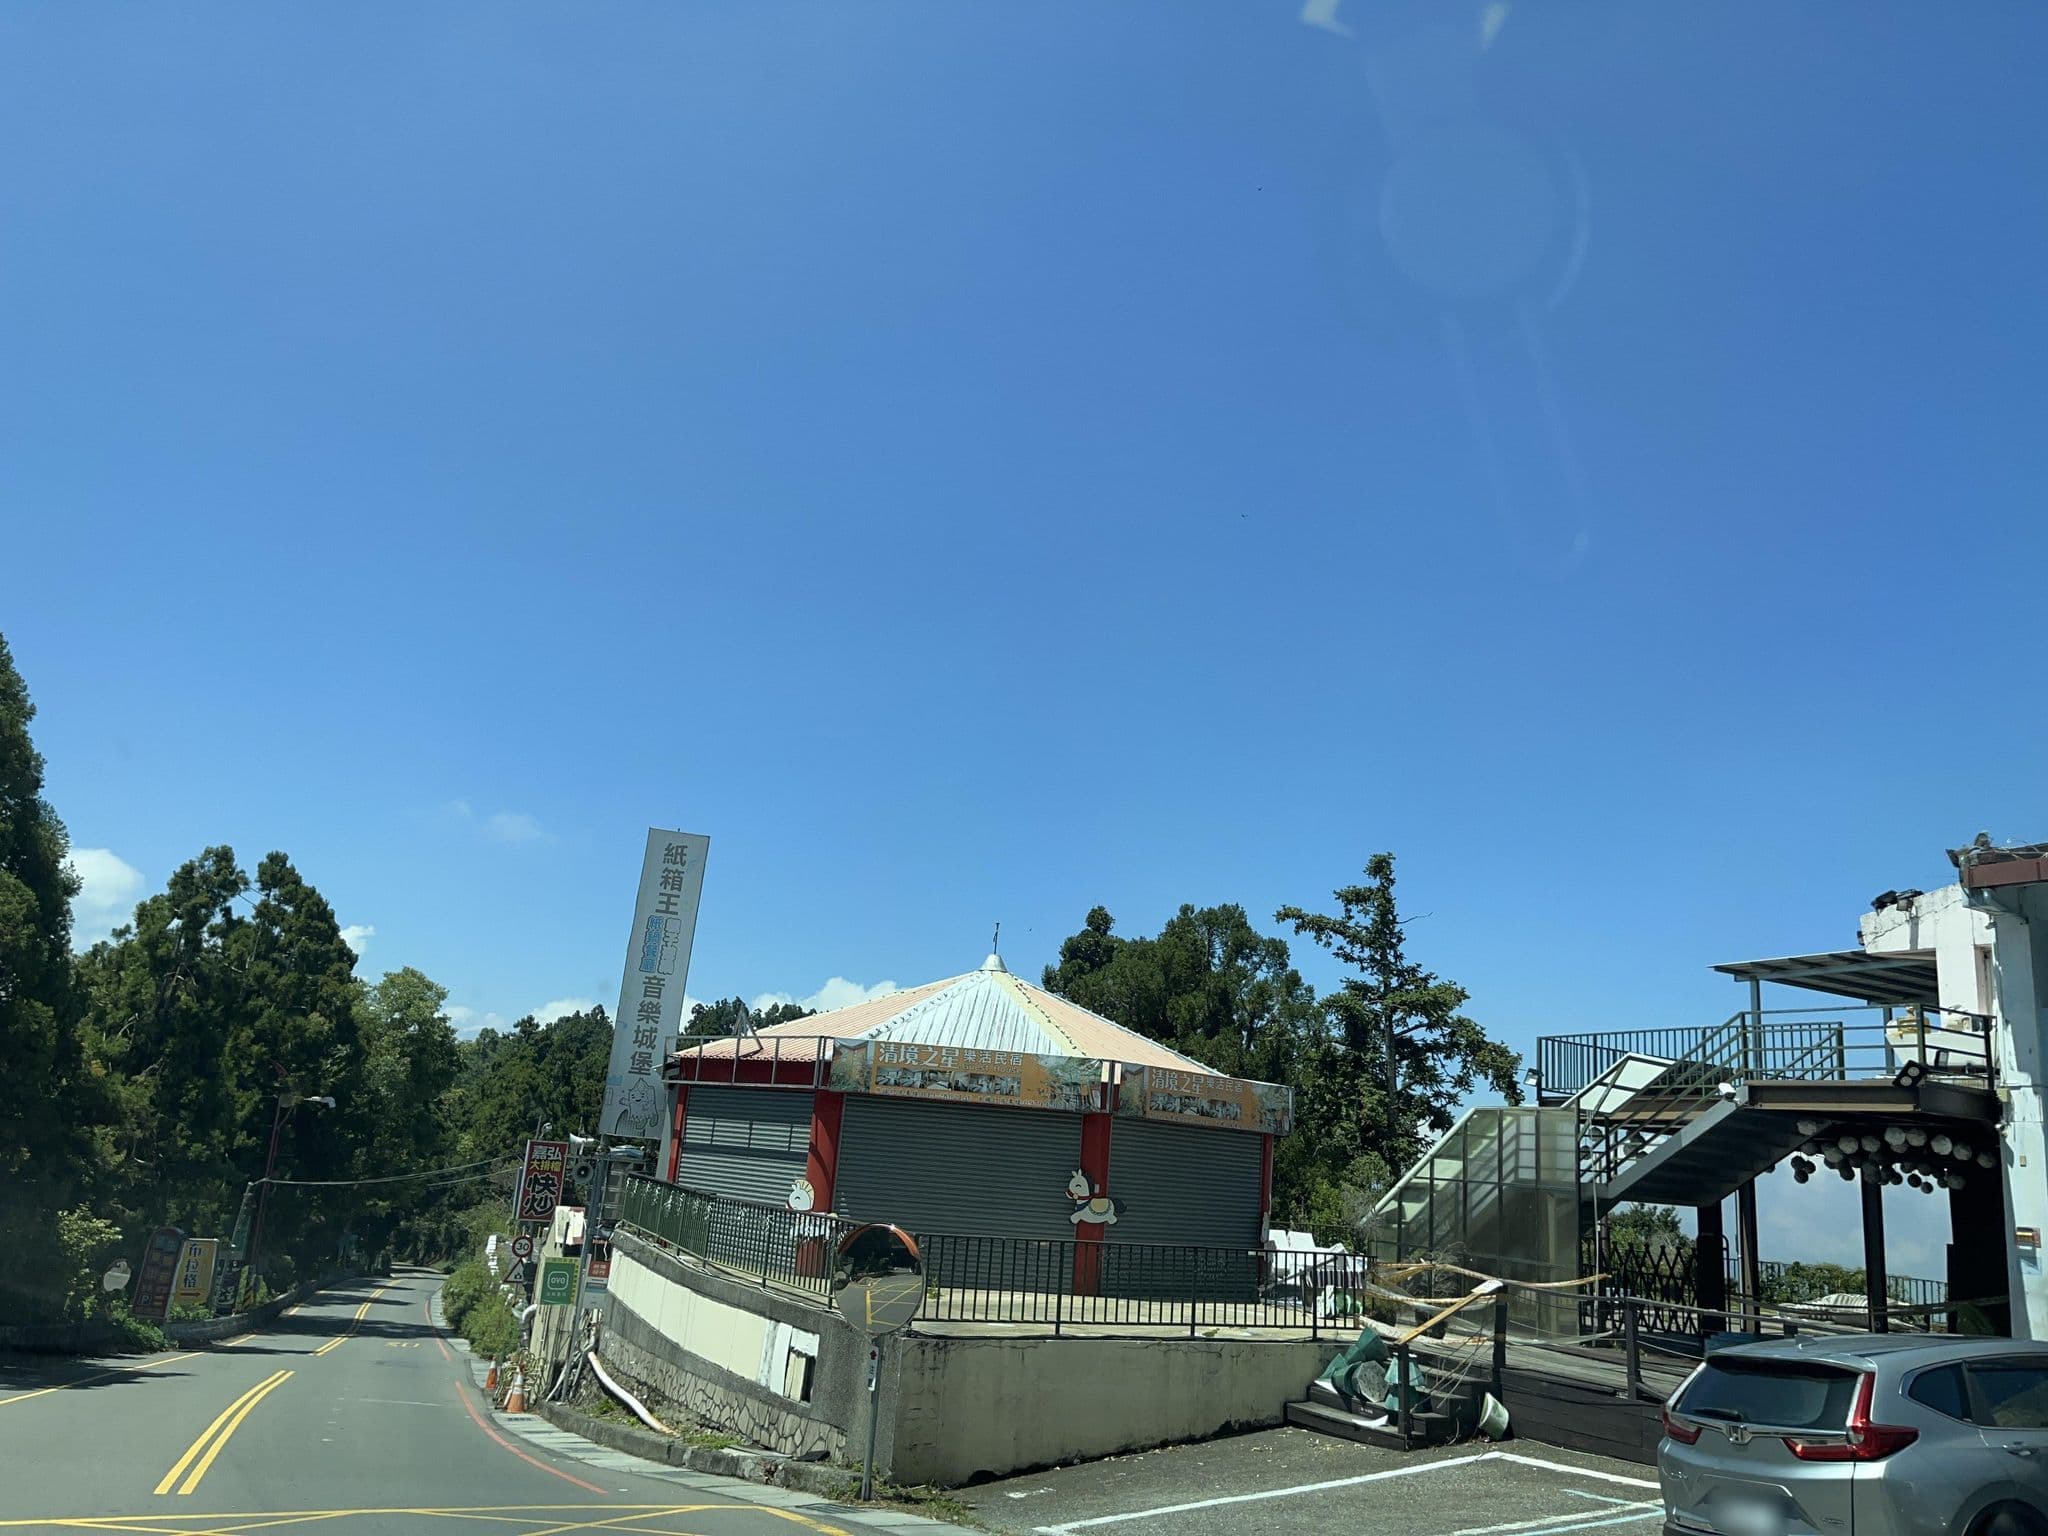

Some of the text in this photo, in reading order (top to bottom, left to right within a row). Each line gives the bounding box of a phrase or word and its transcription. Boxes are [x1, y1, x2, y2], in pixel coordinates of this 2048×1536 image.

[655, 842, 688, 917] 紙箱王
[628, 975, 666, 1076] 音樂城堡
[878, 1042, 1024, 1070] 清境之星 樂活民宿
[1151, 1068, 1204, 1095] 清境之星
[523, 1172, 558, 1217] 快炒
[184, 1243, 202, 1288] 布拉格
[516, 1242, 529, 1251] 30
